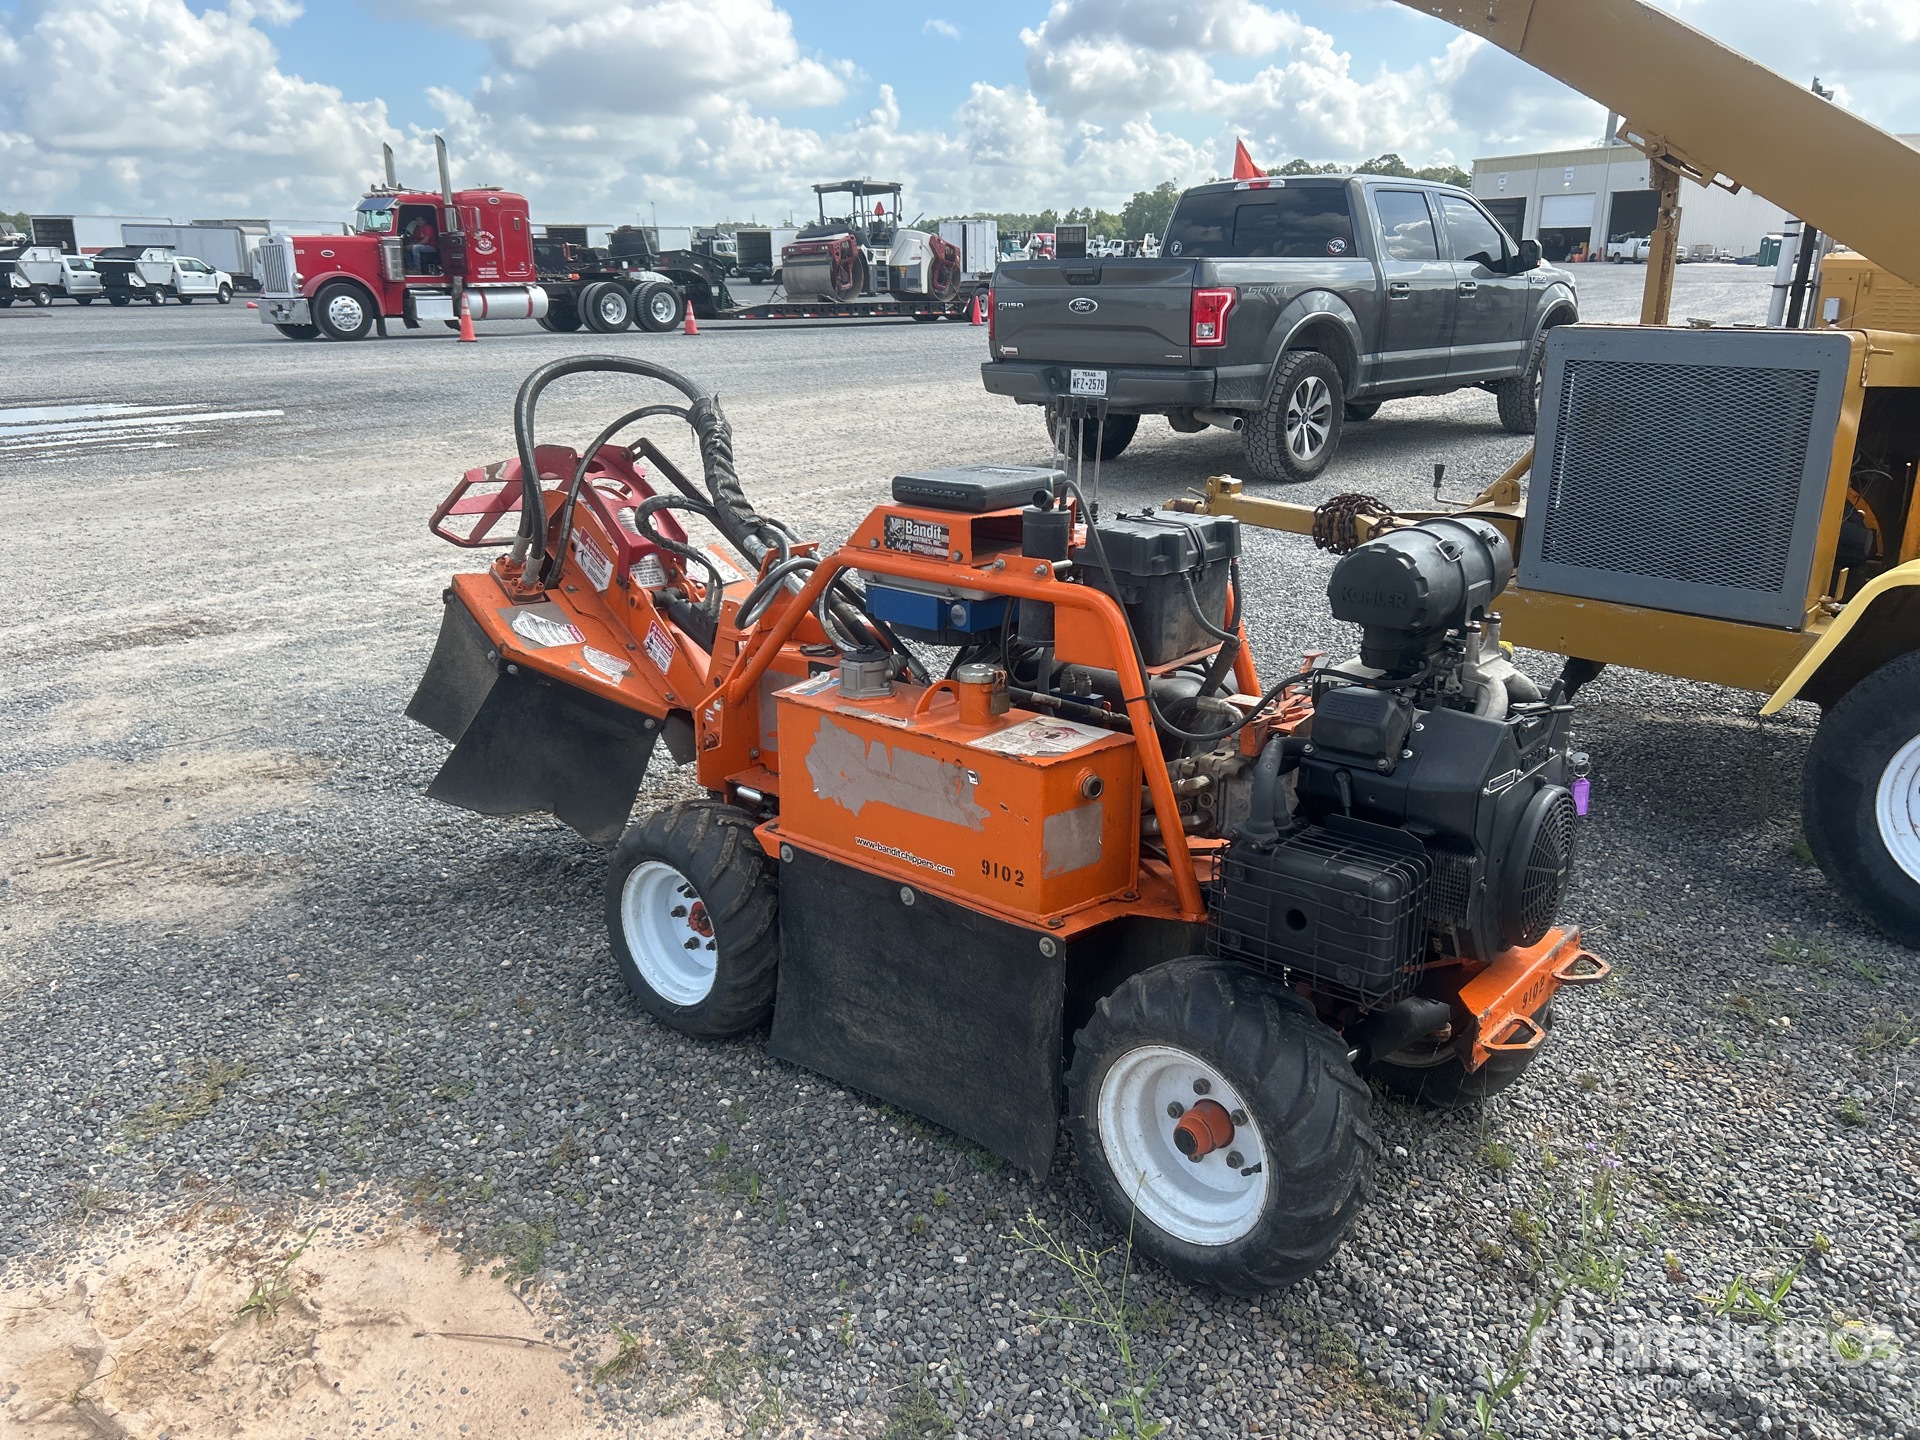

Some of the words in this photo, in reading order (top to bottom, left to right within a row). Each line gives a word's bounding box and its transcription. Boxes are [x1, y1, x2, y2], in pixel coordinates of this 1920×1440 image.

[1073, 300, 1092, 312] Ford
[905, 520, 942, 540] Bandit
[1341, 586, 1407, 609] KOHLER
[855, 836, 955, 877] www.banditchippers.com
[981, 859, 1025, 888] 9102
[1521, 974, 1545, 1010] 9102
